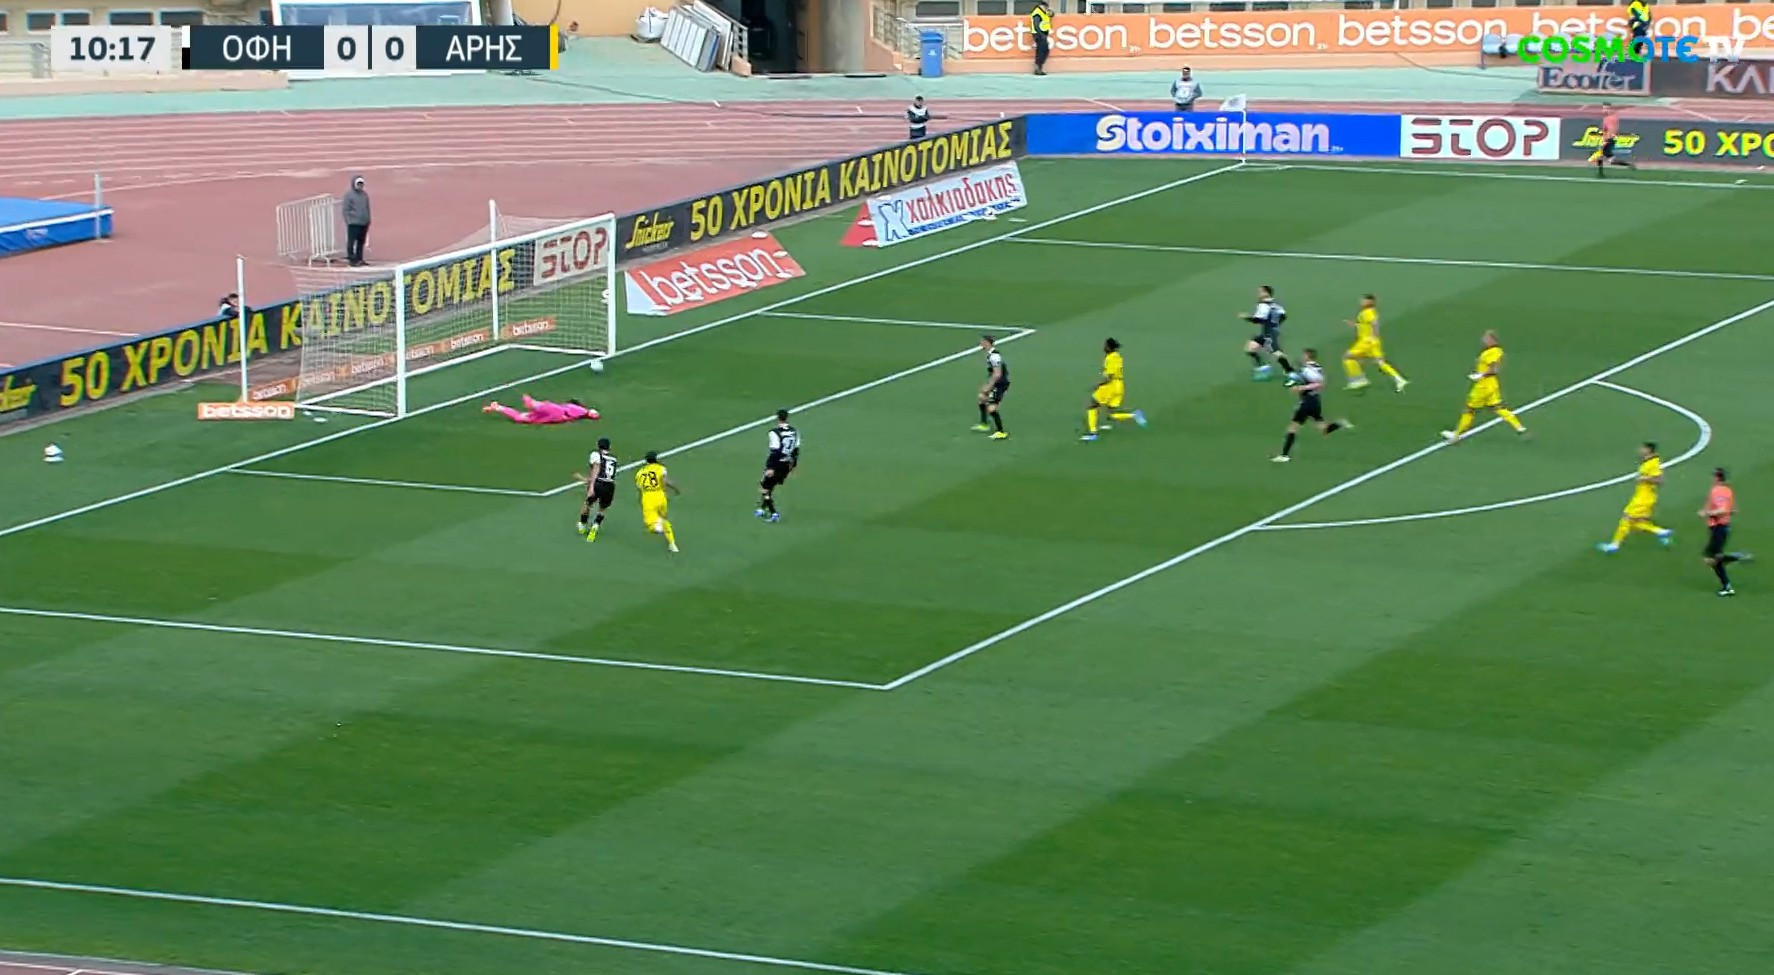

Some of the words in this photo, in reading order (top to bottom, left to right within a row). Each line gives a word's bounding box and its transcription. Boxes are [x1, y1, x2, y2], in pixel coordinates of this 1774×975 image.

[963, 18, 1127, 52] betson
[1150, 17, 1315, 49] betsson
[1337, 14, 1507, 46] betsson
[1096, 115, 1330, 152] Stoiximan
[1411, 117, 1549, 158] STOP
[1664, 129, 1706, 155] 50
[690, 195, 723, 242] 50
[730, 167, 832, 230] ΧΡΟΝΙΑ
[838, 121, 1013, 200] ΚΑΙΝΟΤΟΜΙΑΣ
[540, 227, 608, 280] STOP
[638, 248, 784, 305] betsson
[60, 351, 110, 407] 50
[119, 312, 269, 393] ΧΡΟΝΙΑ
[202, 403, 293, 418] betsson
